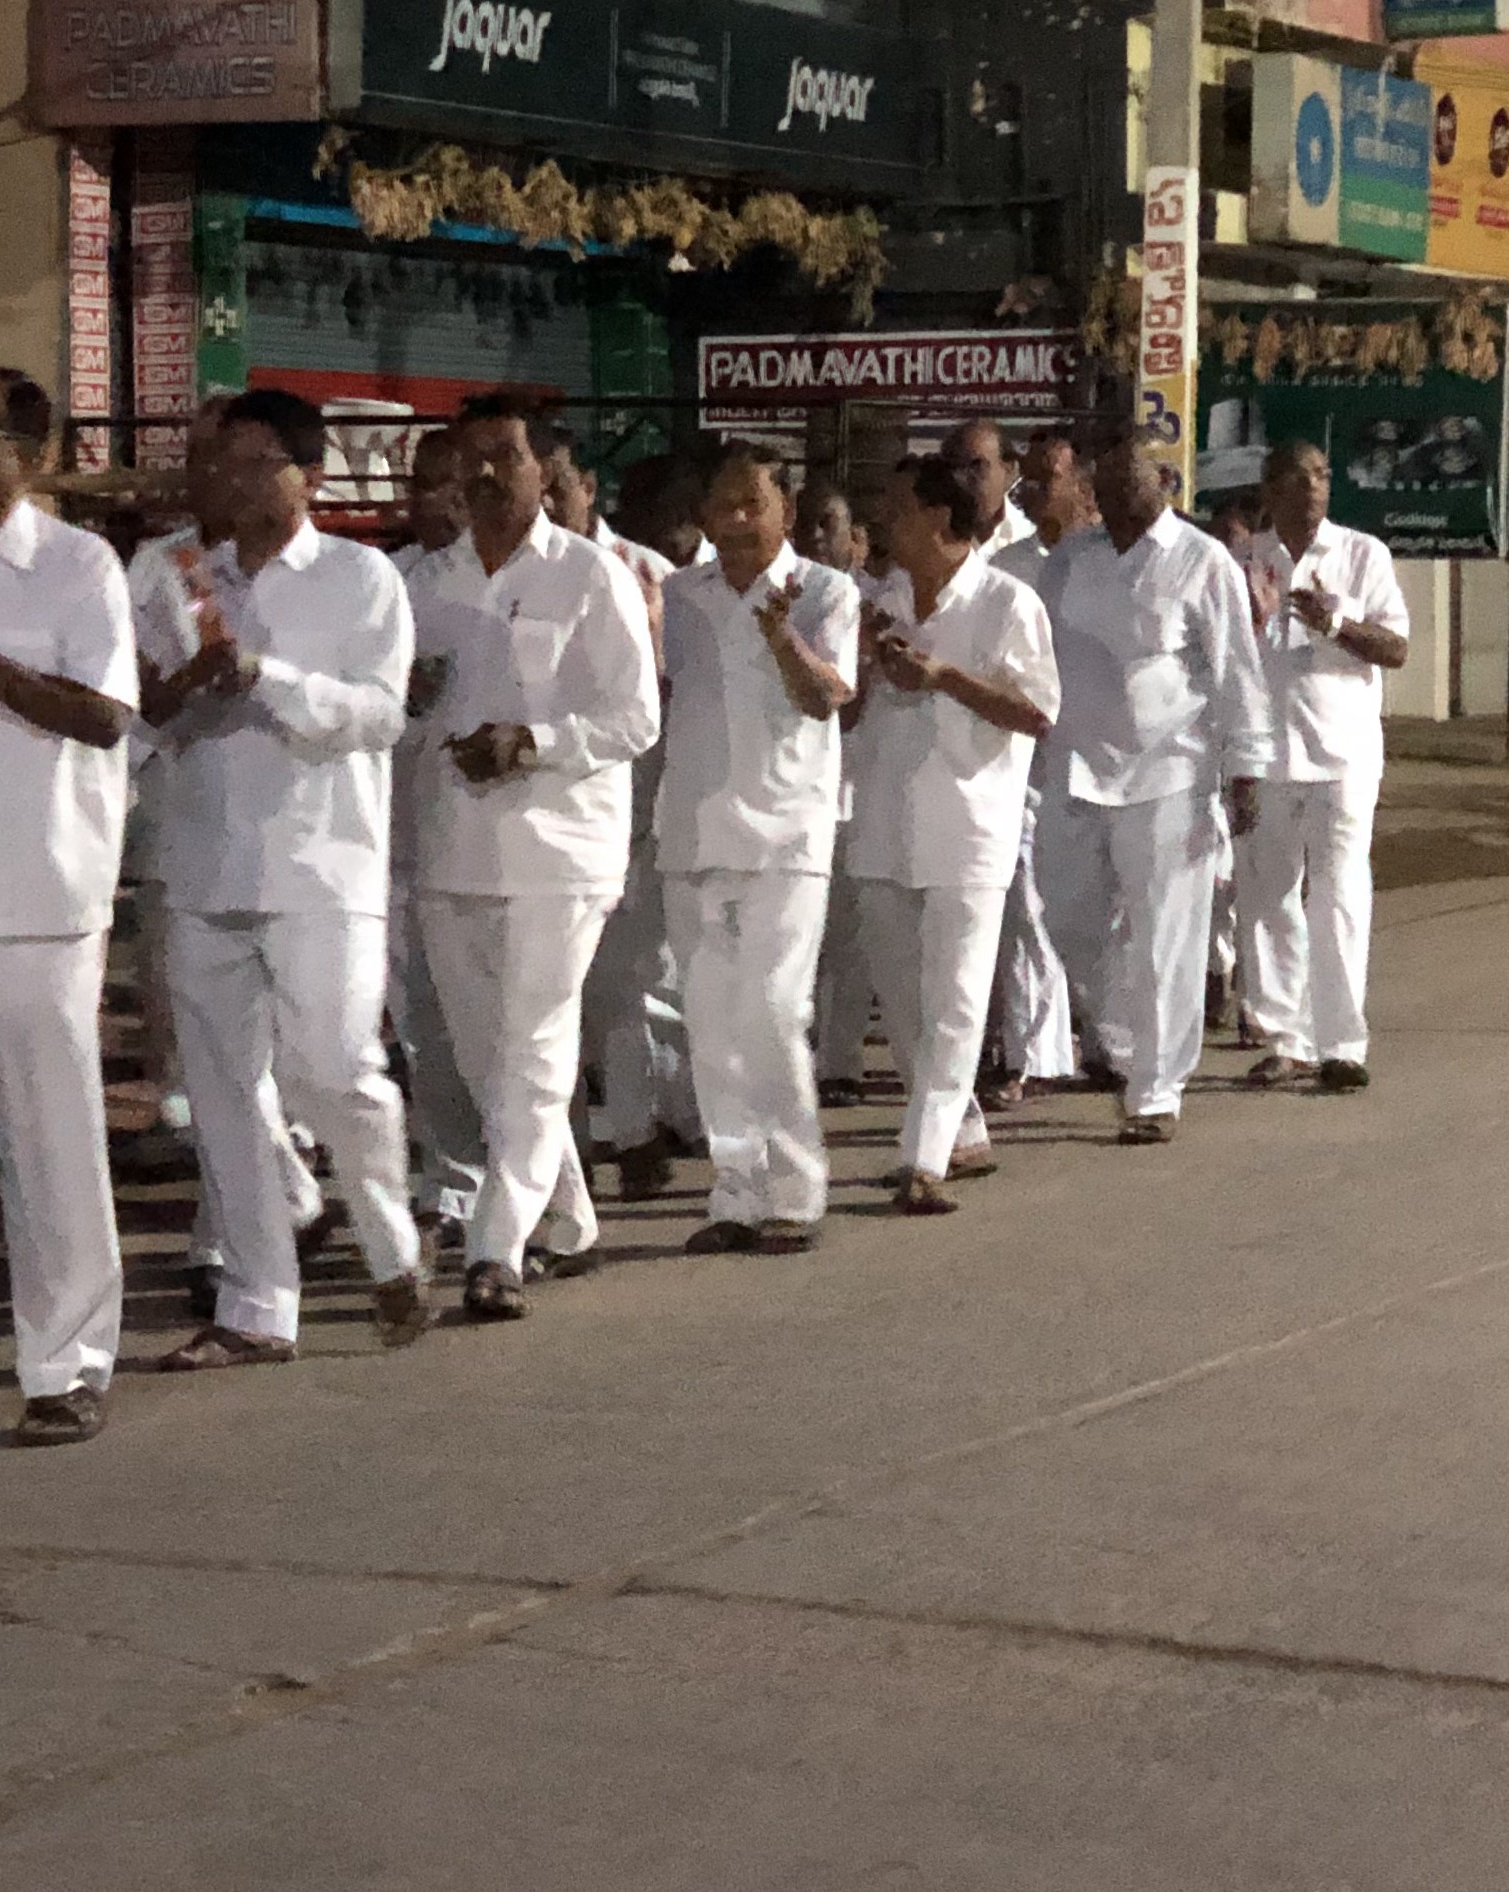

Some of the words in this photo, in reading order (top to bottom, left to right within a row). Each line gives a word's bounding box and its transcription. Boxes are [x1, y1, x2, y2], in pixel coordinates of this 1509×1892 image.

[65, 3, 297, 48] PADMAVATHI
[87, 56, 274, 99] CERAMICS
[709, 347, 935, 389] PADMAVATHI
